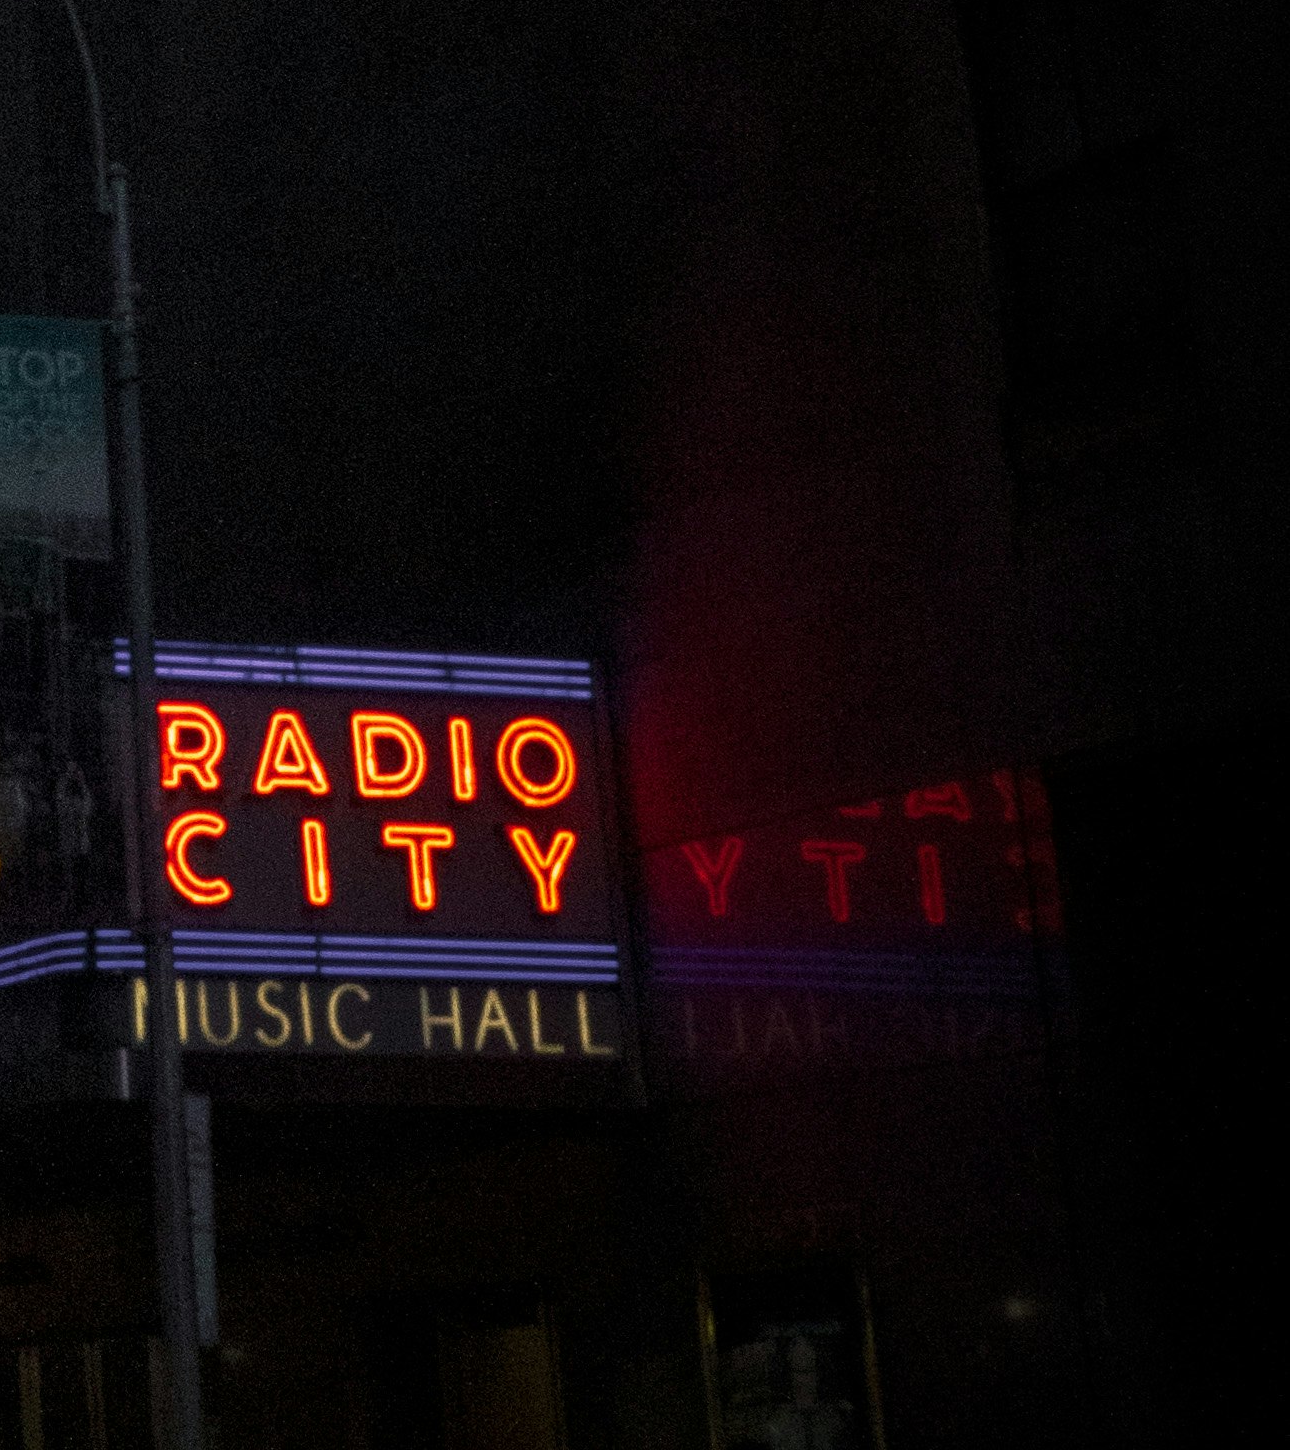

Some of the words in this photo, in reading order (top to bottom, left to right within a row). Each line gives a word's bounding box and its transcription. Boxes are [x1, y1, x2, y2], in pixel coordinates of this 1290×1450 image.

[154, 698, 579, 809] RADIO
[162, 809, 579, 915] CITY
[132, 976, 375, 1051] MUSIC
[421, 987, 616, 1055] HALL
